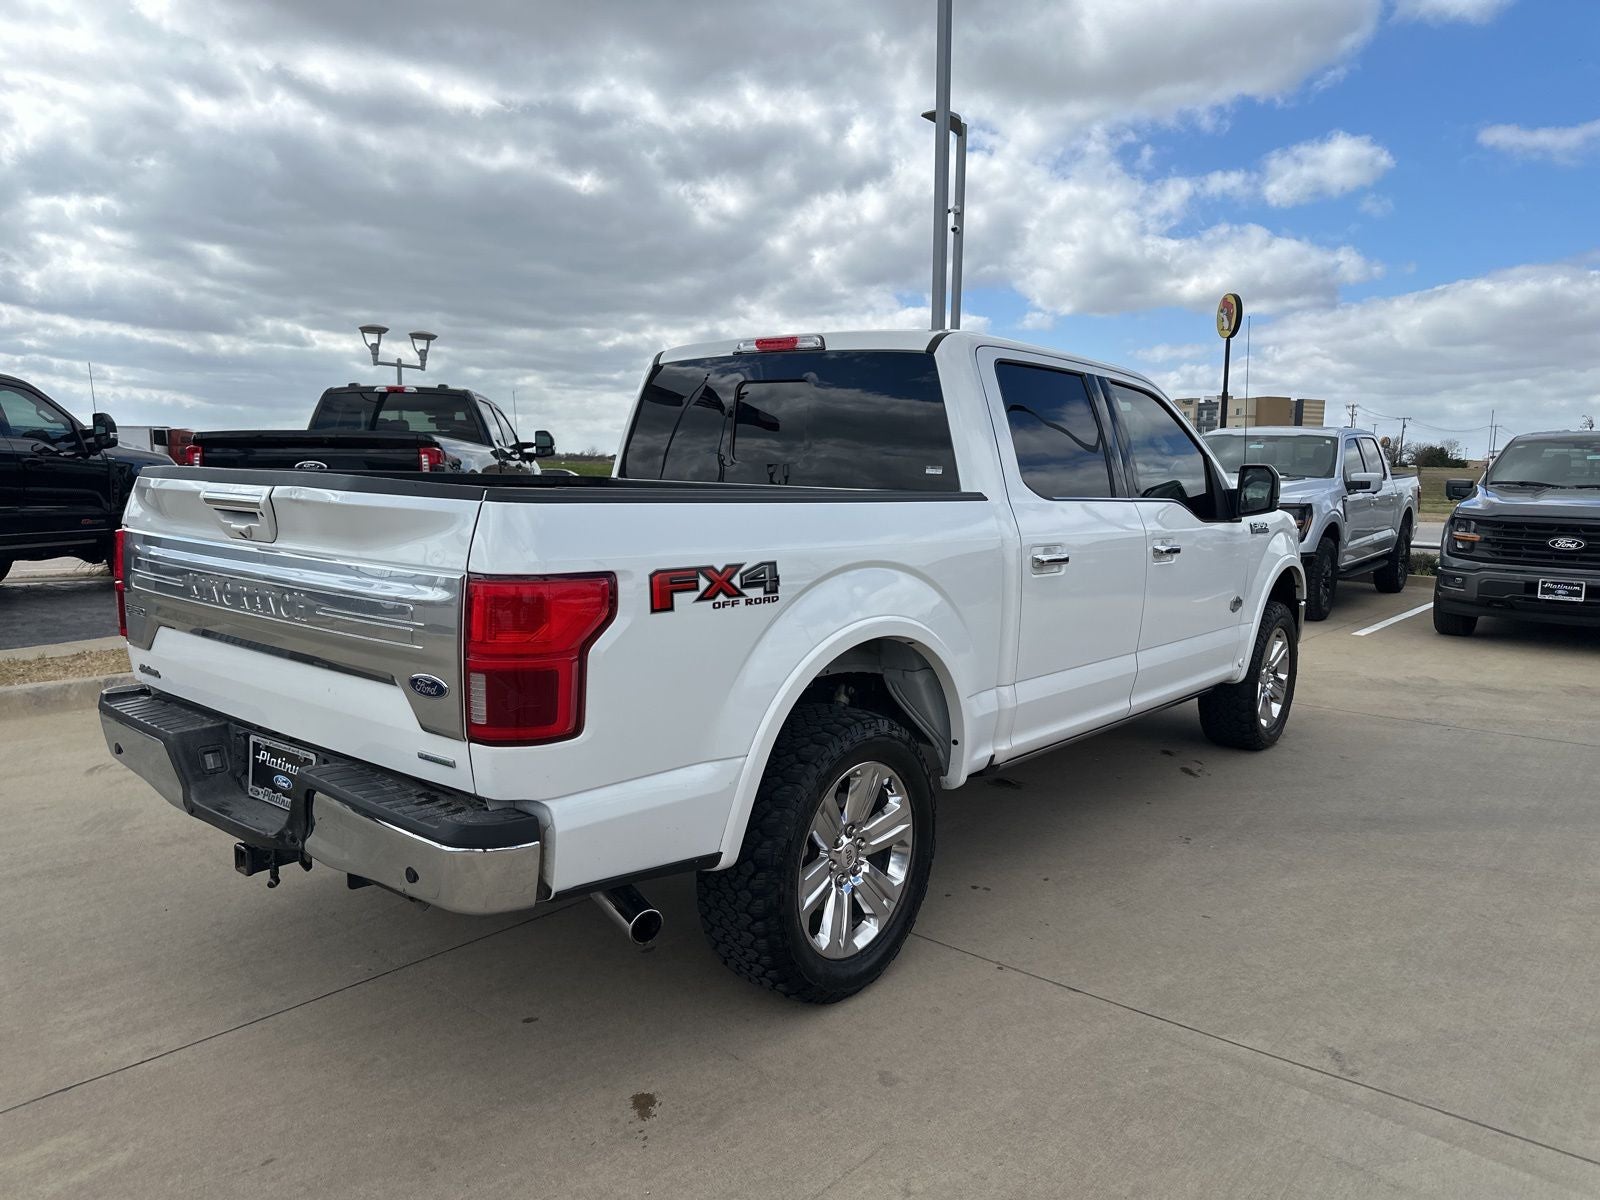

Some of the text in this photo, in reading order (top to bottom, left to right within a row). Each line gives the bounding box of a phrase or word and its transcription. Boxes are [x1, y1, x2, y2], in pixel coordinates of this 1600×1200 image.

[185, 573, 307, 622] KING RANCH
[648, 560, 780, 614] FX4
[1542, 583, 1581, 592] Platinum
[712, 595, 780, 610] OFF ROAD
[255, 750, 299, 775] Platinu
[262, 789, 291, 808] Platinu
